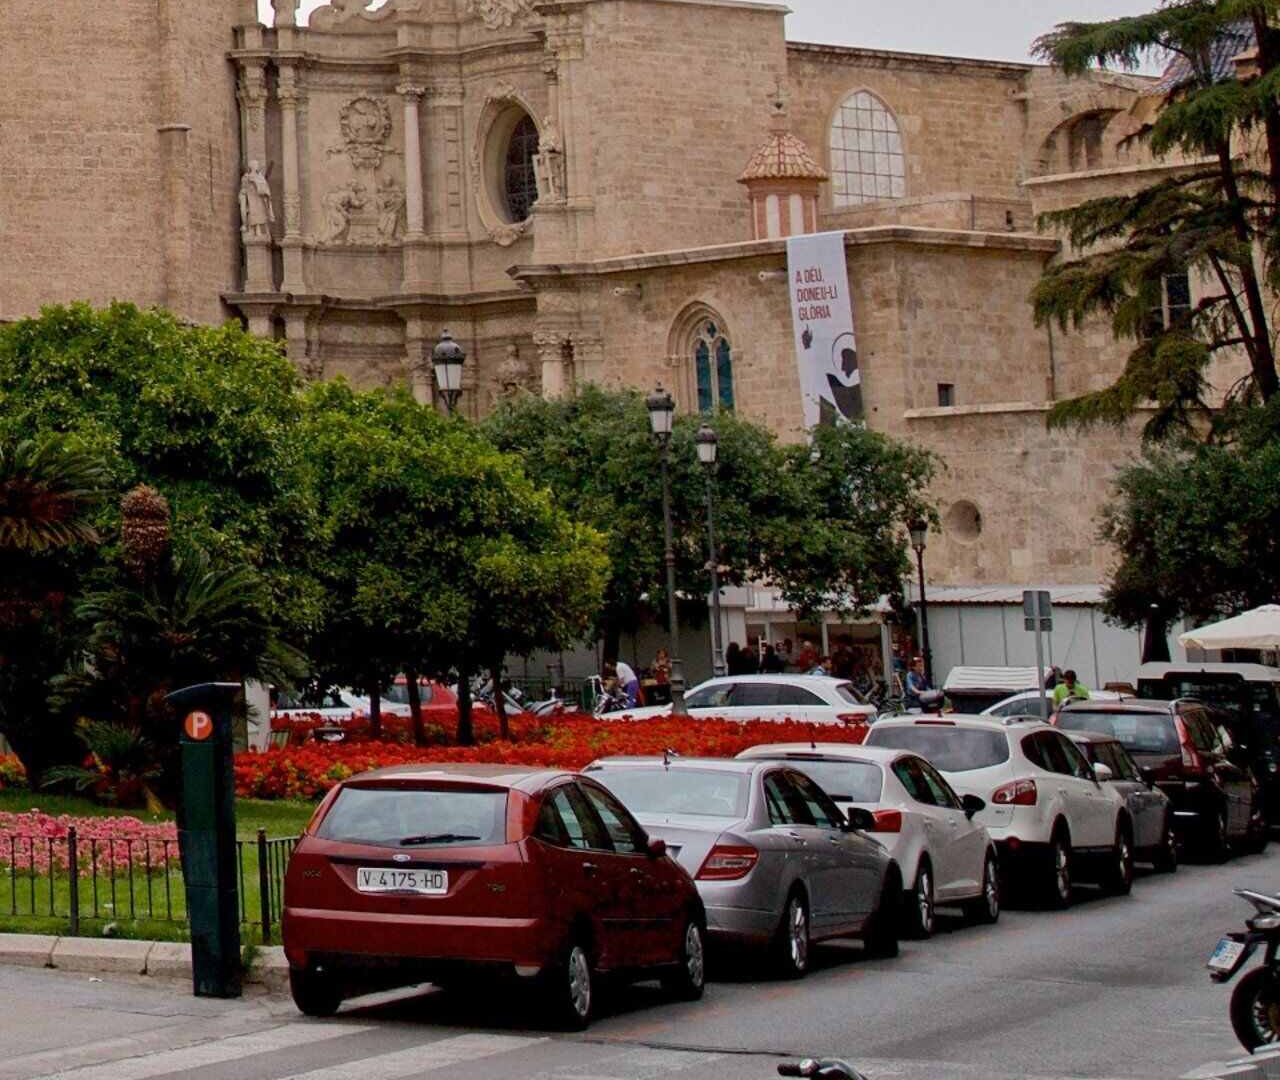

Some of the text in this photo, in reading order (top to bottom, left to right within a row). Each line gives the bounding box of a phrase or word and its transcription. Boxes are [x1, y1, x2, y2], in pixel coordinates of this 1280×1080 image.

[795, 270, 803, 284] A
[796, 285, 838, 302] DONEU-LI
[192, 711, 208, 737] P
